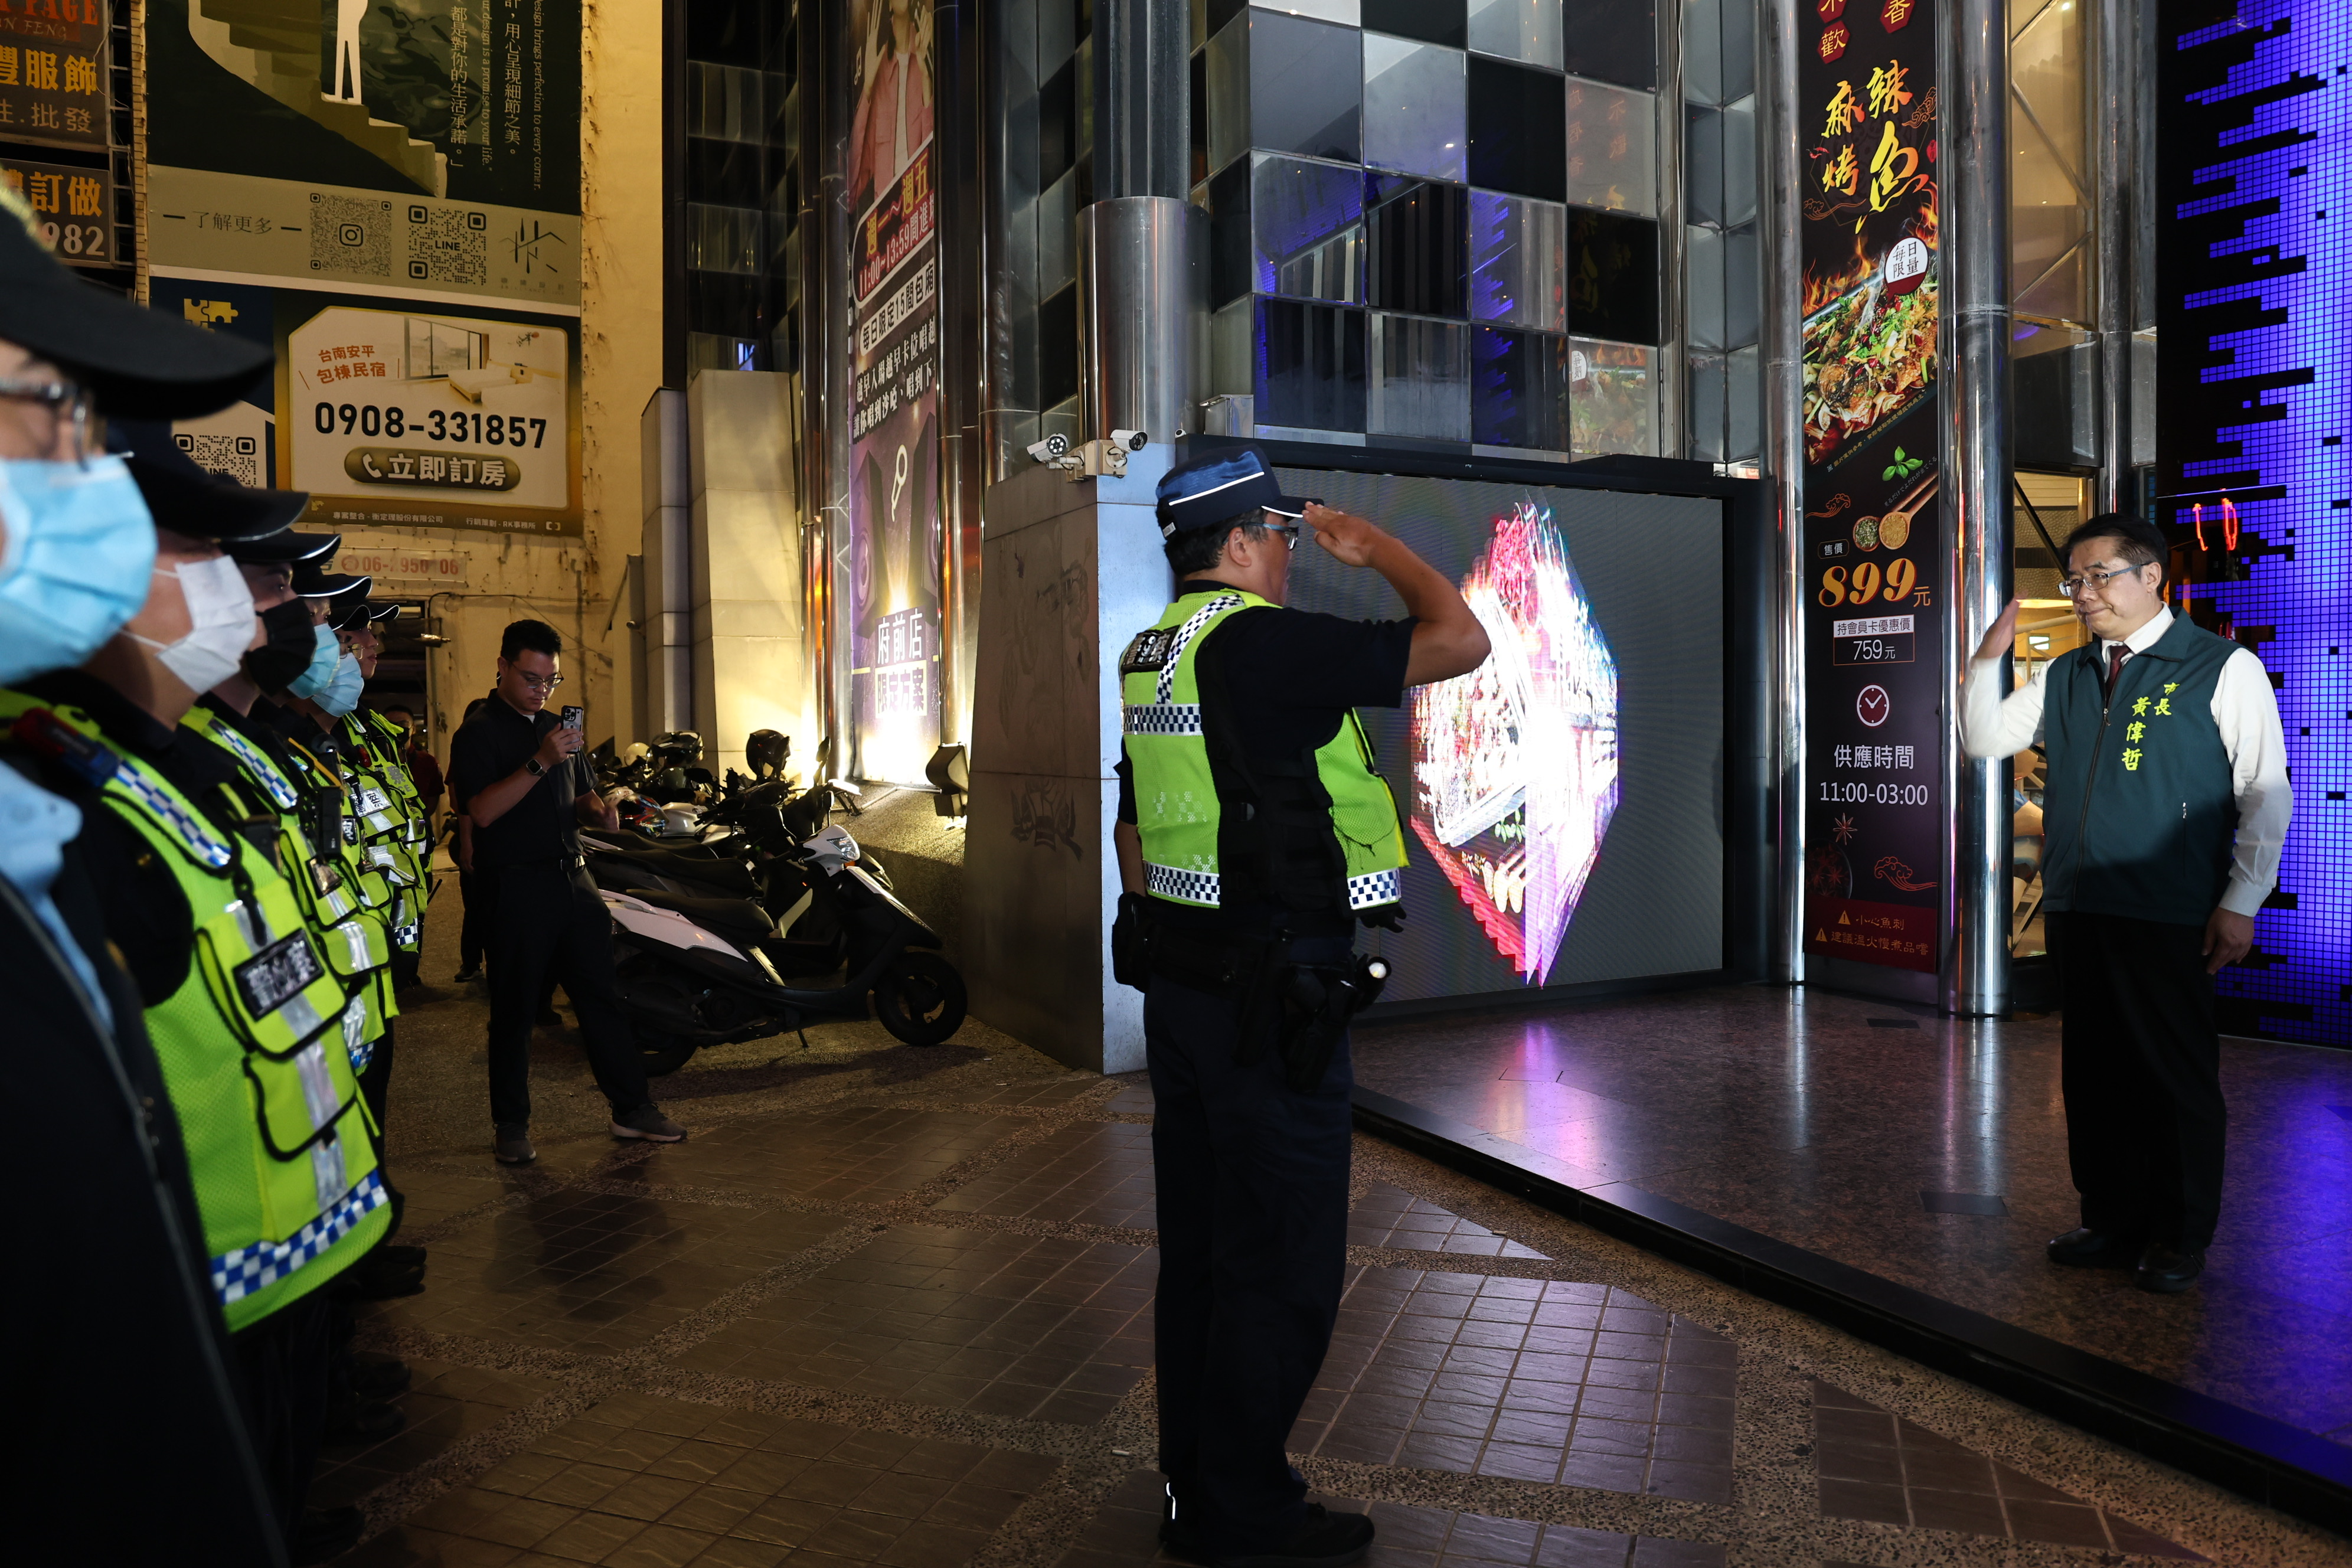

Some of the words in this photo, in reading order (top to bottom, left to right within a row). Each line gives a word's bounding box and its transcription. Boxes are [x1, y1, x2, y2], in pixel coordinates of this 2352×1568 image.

[481, 12, 493, 45] design
[482, 48, 493, 57] is
[533, 29, 544, 60] brings
[481, 67, 493, 106] promise
[533, 61, 545, 112] perfection
[482, 109, 491, 119] to
[533, 115, 543, 125] to
[481, 121, 491, 146] your
[533, 127, 541, 155] every
[192, 210, 272, 234] 了解更多
[435, 240, 460, 251] LINE
[318, 345, 375, 363] 台南安平
[316, 361, 386, 385] 包棟民宿
[315, 402, 547, 449] 0908-331857
[387, 453, 507, 487] 立即訂房
[1824, 543, 1843, 556] 售價
[877, 607, 923, 665] 府前店
[1837, 618, 1910, 636] 持會員卡優惠價
[2154, 682, 2180, 716] 市長
[2121, 697, 2152, 771] 黃偉哲
[1834, 744, 1914, 770] 供應時間
[1820, 781, 1929, 806] 11:00-03:00
